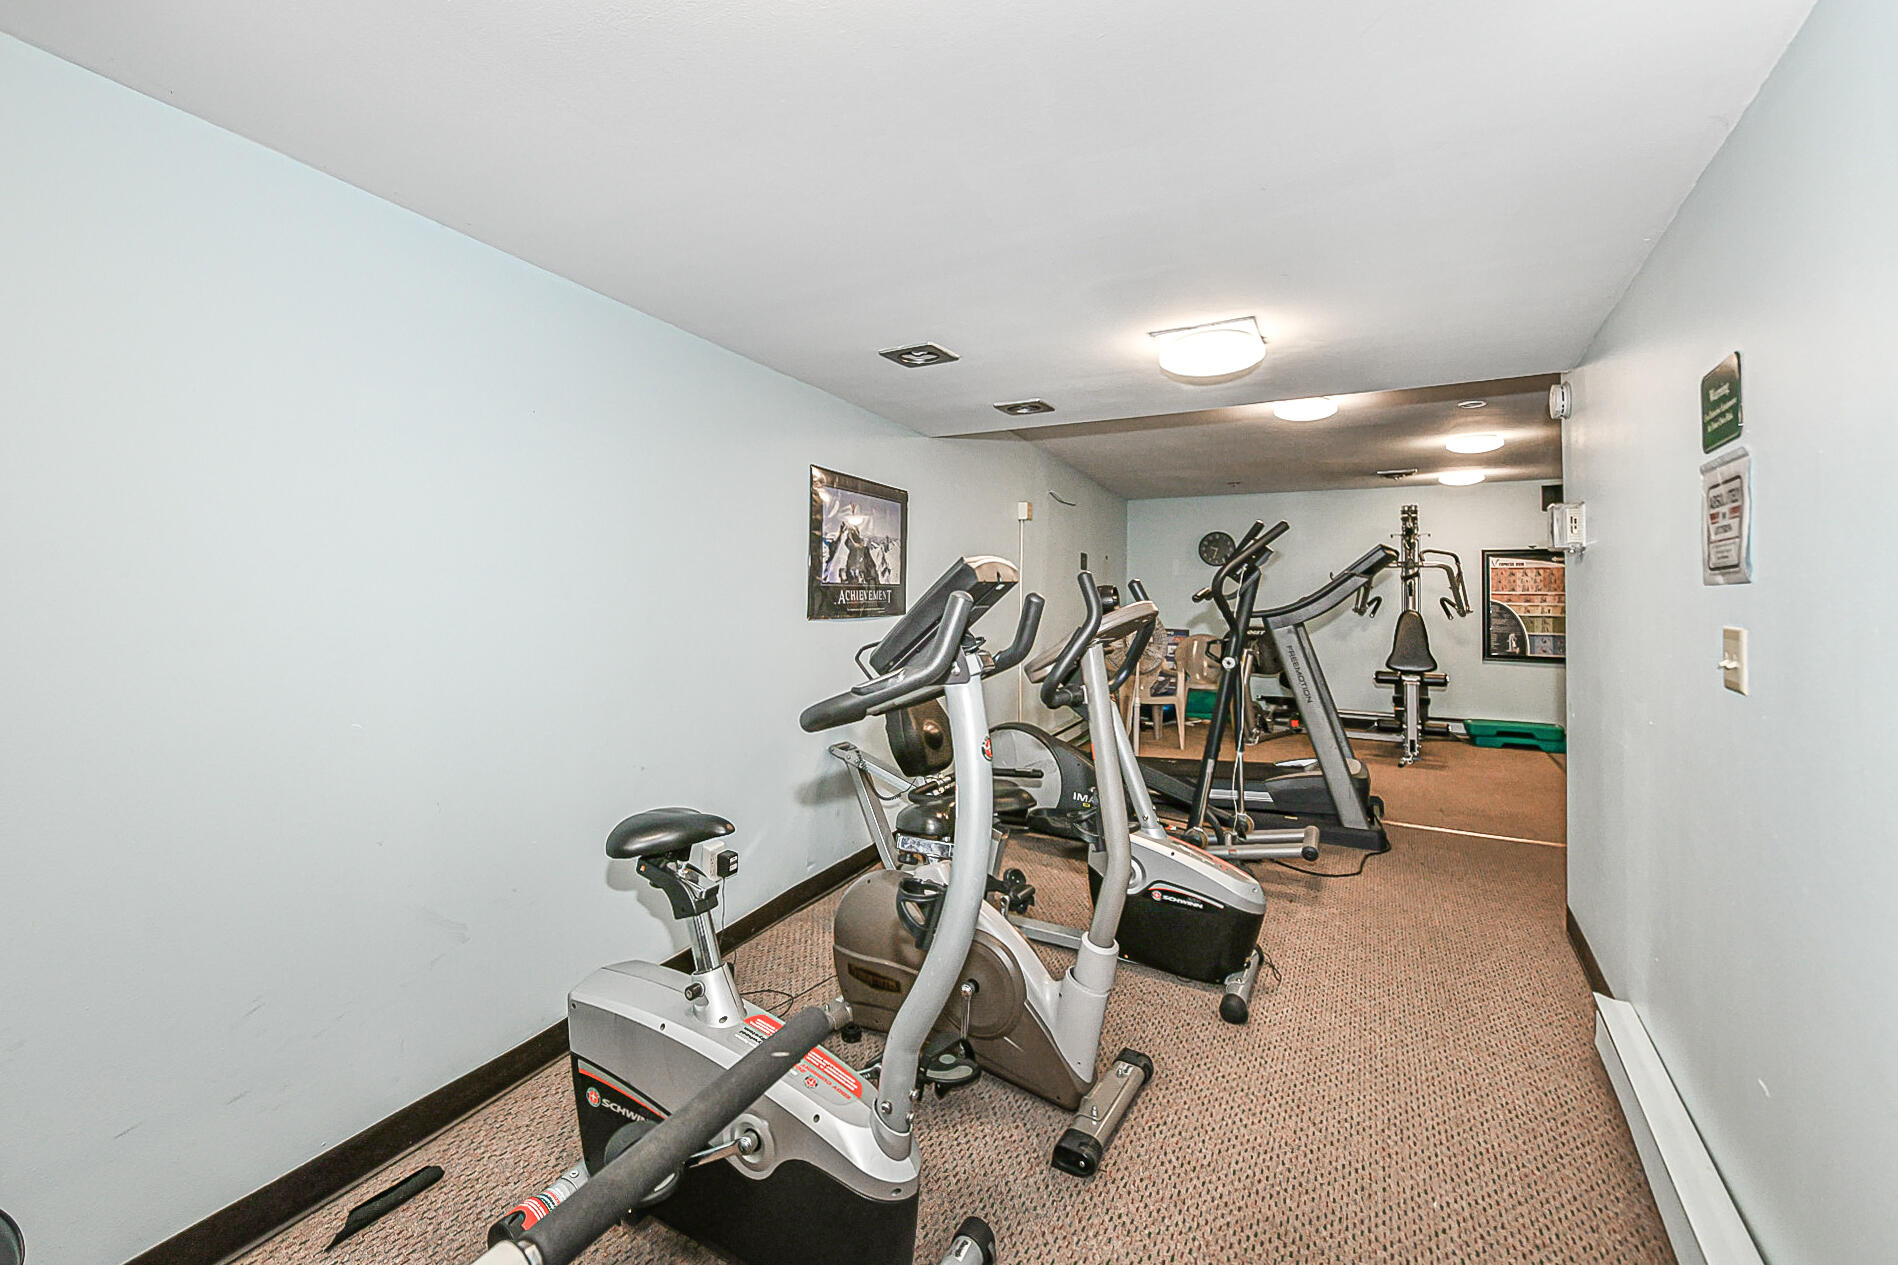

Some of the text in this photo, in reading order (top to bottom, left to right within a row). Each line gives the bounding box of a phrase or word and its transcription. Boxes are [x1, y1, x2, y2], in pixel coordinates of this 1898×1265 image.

[837, 589, 892, 604] ACHIEVEMENT
[1285, 644, 1313, 704] FREEMOTION
[1162, 894, 1204, 909] SCHWINN
[601, 1098, 649, 1123] SCHWI
